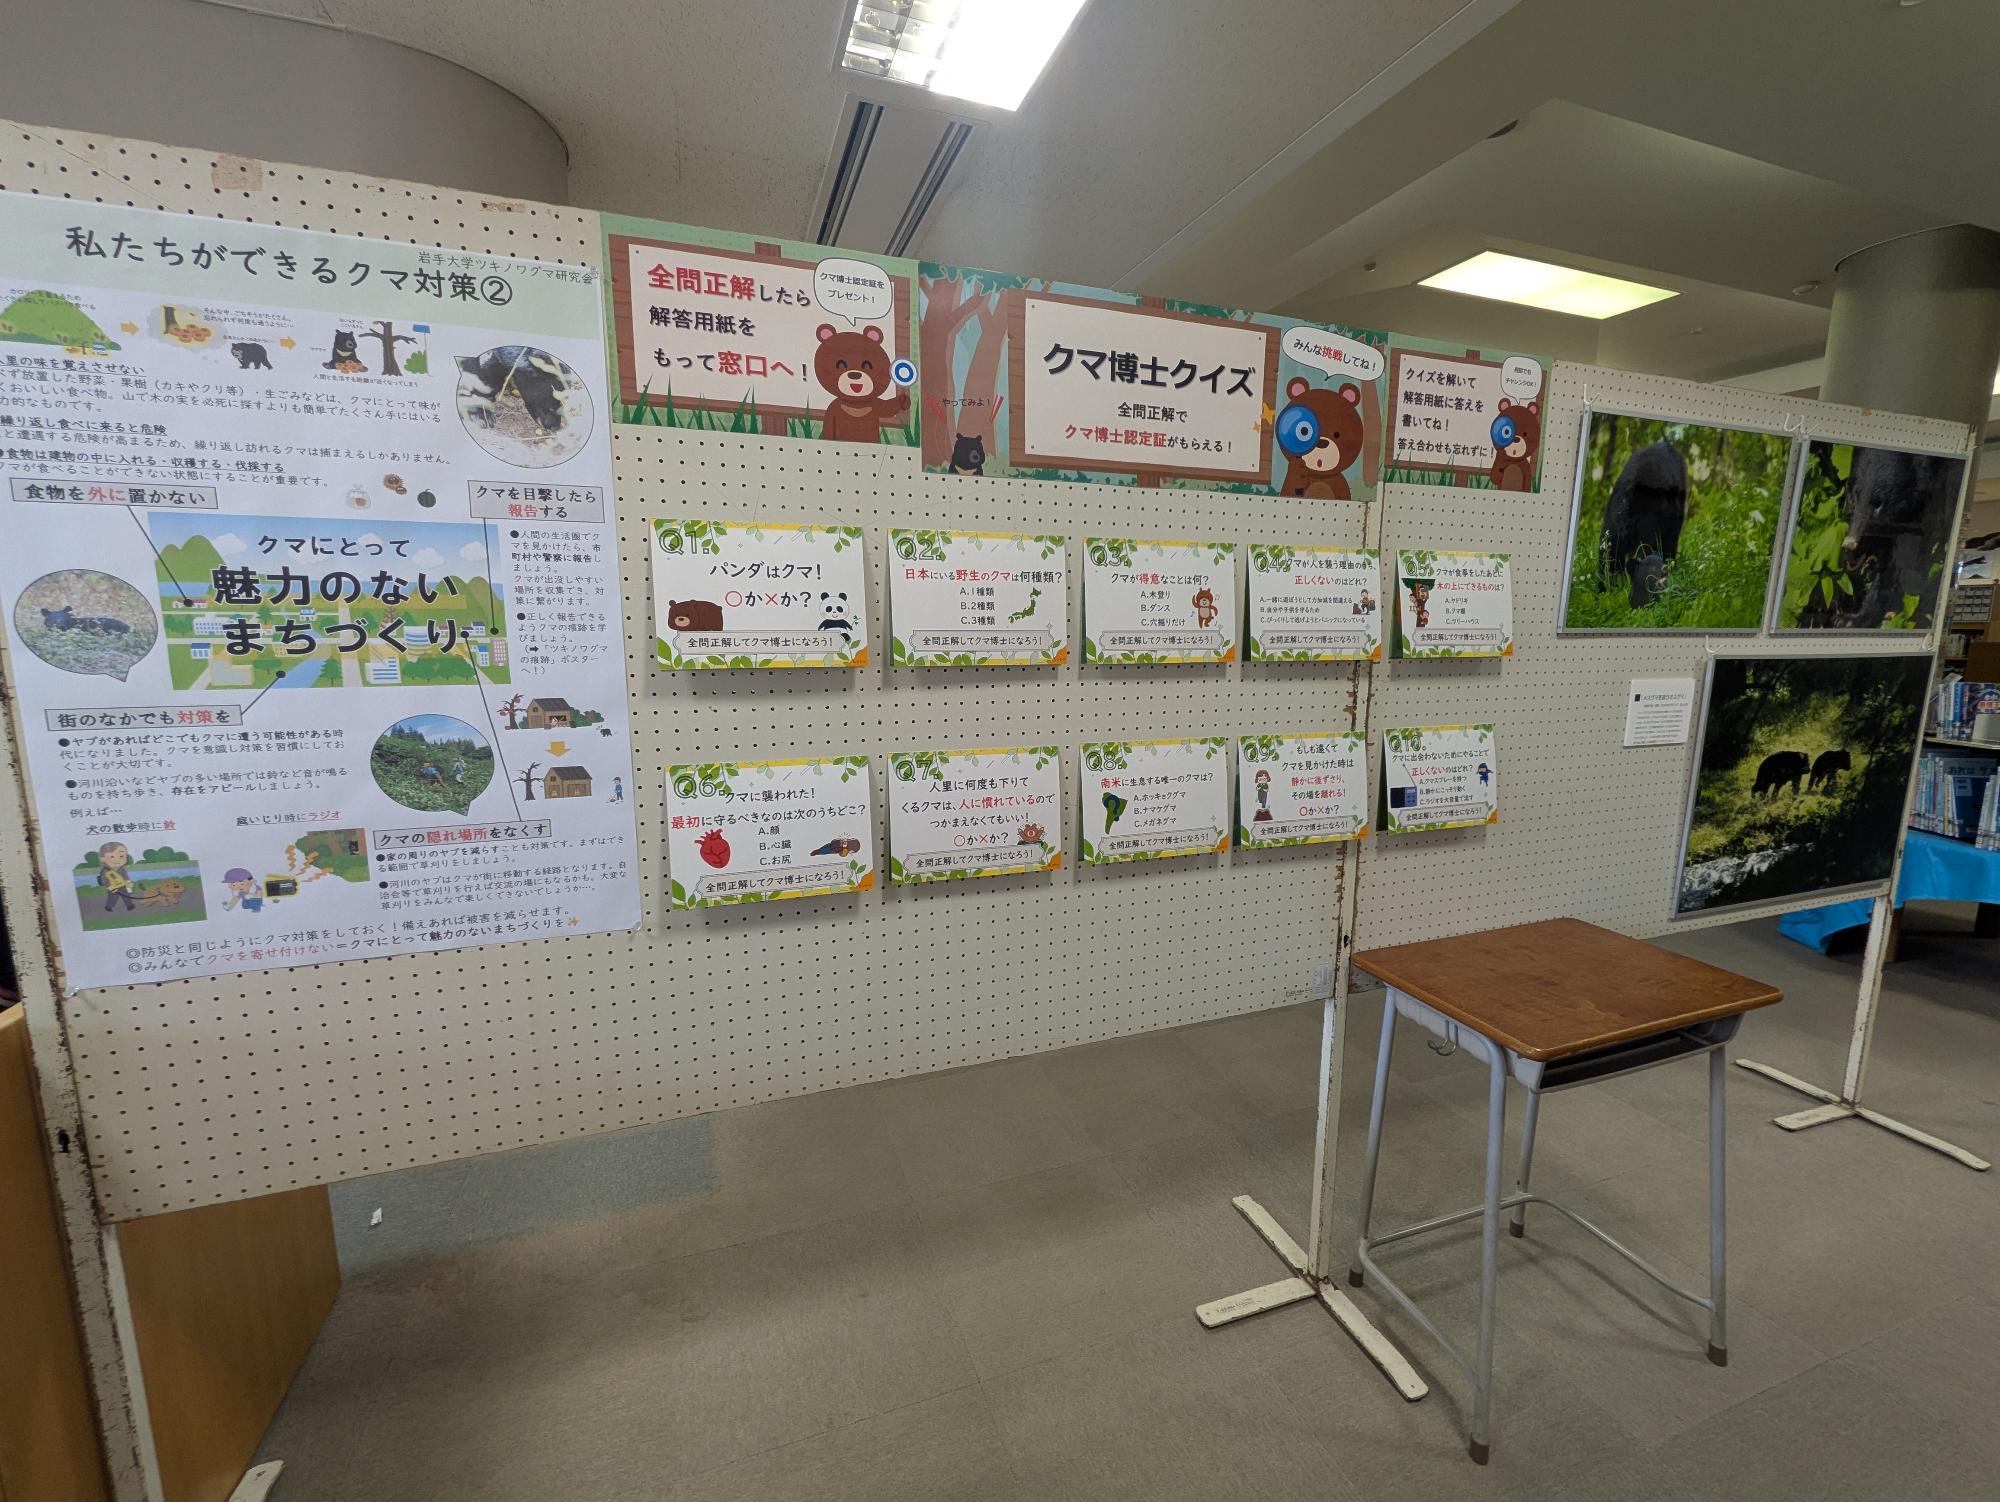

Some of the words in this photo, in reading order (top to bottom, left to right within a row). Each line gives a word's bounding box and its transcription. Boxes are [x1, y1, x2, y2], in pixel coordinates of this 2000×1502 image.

[65, 226, 513, 306] 私たちができるクマ対策②
[418, 251, 594, 285] 岩手大学ツキノワグマ研究会
[647, 263, 812, 307] 全問正解したら
[819, 272, 886, 290] クマ博士認定証を
[827, 289, 877, 304] プレゼント！
[649, 305, 756, 336] 解答用紙を
[1293, 338, 1377, 371] みんな挑戦してね！
[653, 347, 808, 382] もって窓口へ！
[1043, 342, 1256, 398] クマ博士クイズ
[1405, 367, 1477, 389] クイズを解いて
[1403, 391, 1485, 413] 解答用紙に答えを
[1117, 402, 1188, 423] 全問正解で
[1402, 413, 1450, 431] 書いてね！
[1065, 423, 1233, 453] クマ博士認定証がもらえる！
[1397, 437, 1495, 459] 答え合わせも忘れずに！
[24, 483, 206, 504] 食物を外に置かない
[477, 486, 596, 503] クマを目撃したら
[508, 503, 568, 518] 報告する
[258, 535, 411, 558] クマにとって
[511, 552, 601, 563] 町村や警察に報告し
[513, 563, 559, 572] ましょう。
[709, 561, 822, 580] パンダはクマ！
[905, 568, 1063, 584] 日本にいる野生のクマは何種類？
[1436, 568, 1504, 578] クマが食事をしたあとに
[212, 564, 459, 606] 魅力のない
[1111, 572, 1209, 586] クマが得意なことは何？
[1294, 575, 1368, 586] 正しくないのはどれ？
[1436, 582, 1505, 592] 木の上にできるものは？
[959, 586, 995, 597] A.1種類
[1140, 590, 1171, 600] A.木登り
[960, 601, 995, 611] B.2種類
[1140, 604, 1171, 612] B.ダンス
[960, 616, 996, 626] C.3種類
[222, 617, 459, 656] まちづくり
[519, 634, 574, 643] びましょう。
[687, 637, 834, 648] 全問正解してクマ博士になろう！
[922, 636, 1043, 646] 全問正解してクマ博士になろう！
[1109, 636, 1214, 646] 全問正解してクマ博士になろう！
[1269, 635, 1360, 645] 全問正解してクマ博士になろう！
[1420, 633, 1497, 641] 全問正解してクマ博士になろう！
[58, 709, 231, 728] 街のなかでも対策を
[1281, 758, 1354, 771] クマを見かけた時は
[1411, 764, 1474, 777] 正しくないのはどれ？
[929, 776, 1029, 793] 人里に何度も下りて
[1100, 772, 1214, 789] 南米に生息する唯一のクマは？
[725, 788, 816, 805] クマに襲われた！
[900, 793, 1056, 813] くるクマは、人に慣れているので
[1291, 789, 1346, 800] その場を離れる！
[671, 804, 866, 830] 最初に守るべきなのは次のうちどこ？
[1133, 804, 1177, 815] B.ナマケグマ
[930, 812, 1029, 829] つかまえなくてもいい！
[1134, 817, 1177, 828] C.メガネグマ
[1260, 820, 1348, 836] 全問正解してクマ博士になろう！
[380, 823, 548, 847] クマの隠れ場所をなくす
[758, 825, 780, 836] A.顔
[759, 840, 792, 851] B.心臓
[1109, 833, 1209, 850] 全問正解してクマ博士になろう！
[759, 855, 792, 867] C.お尻
[916, 850, 1034, 868] 全問正解してクマ博士になろう！
[705, 870, 845, 893] 全問正解してクマ博士になろう！
